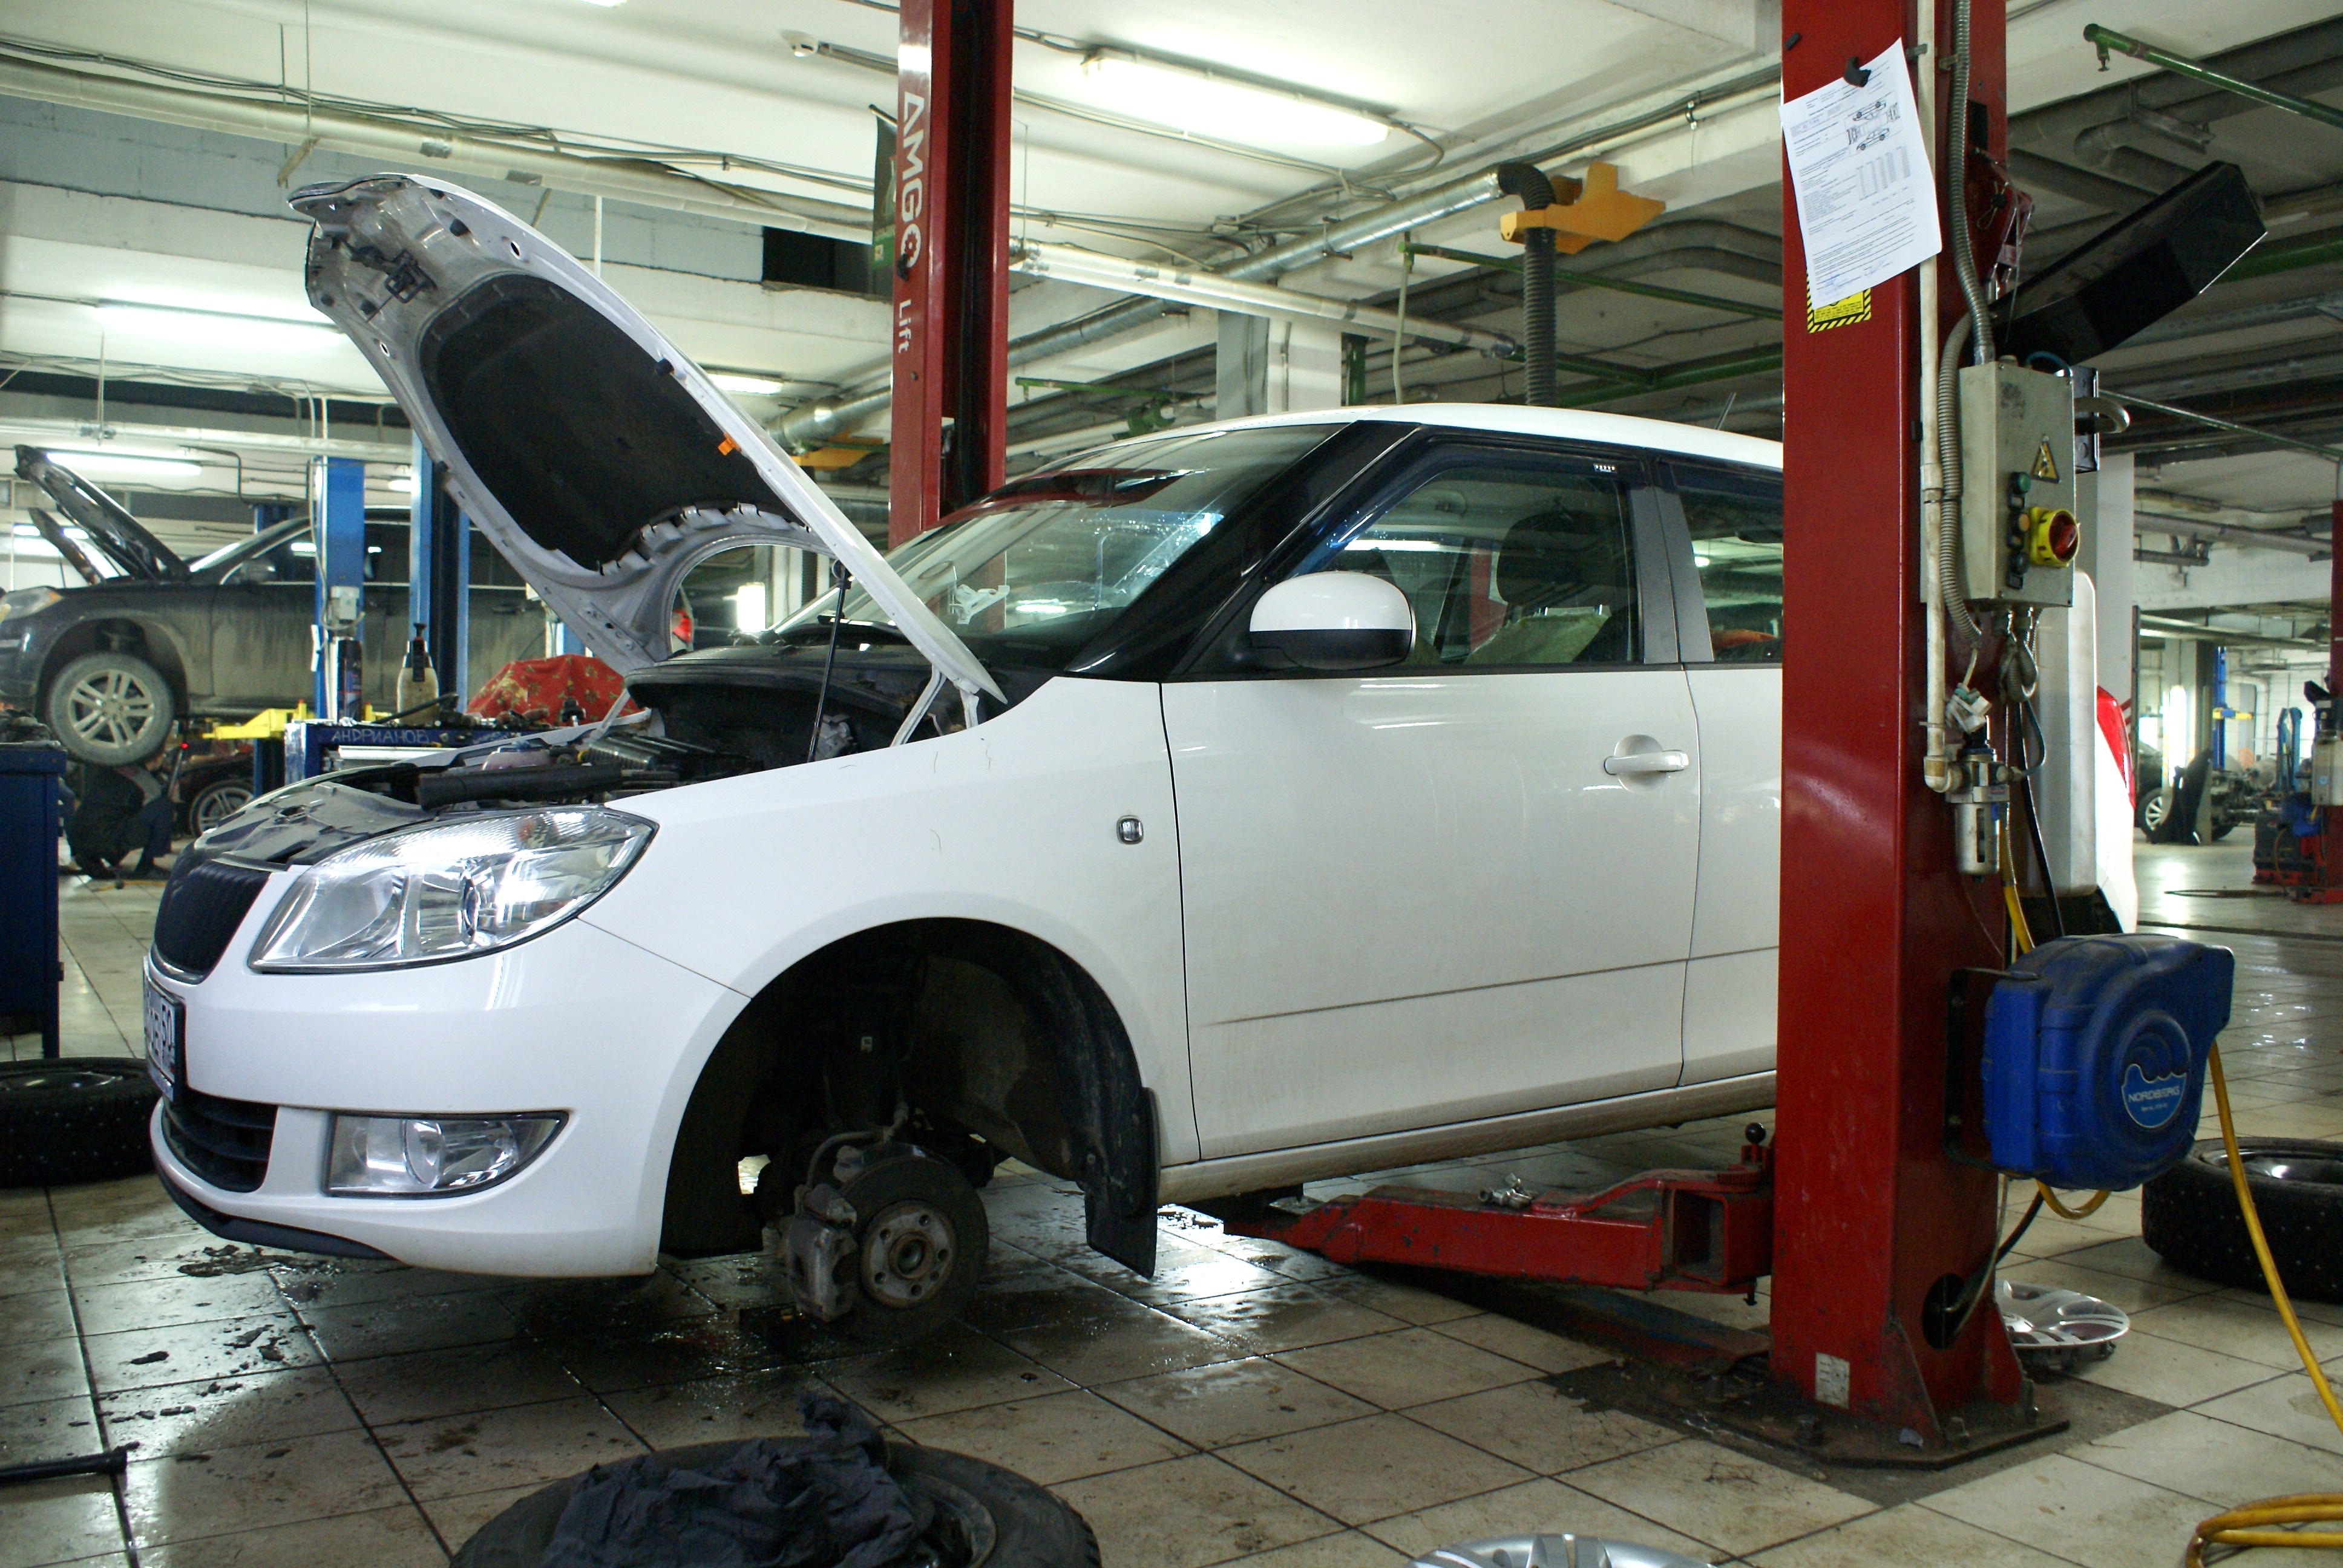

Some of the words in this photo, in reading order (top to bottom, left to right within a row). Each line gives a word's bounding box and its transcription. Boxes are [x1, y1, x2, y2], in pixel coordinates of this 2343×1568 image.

[901, 91, 925, 268] AMGO
[898, 299, 912, 354] Lift
[2128, 1086, 2180, 1102] NORDBERG
